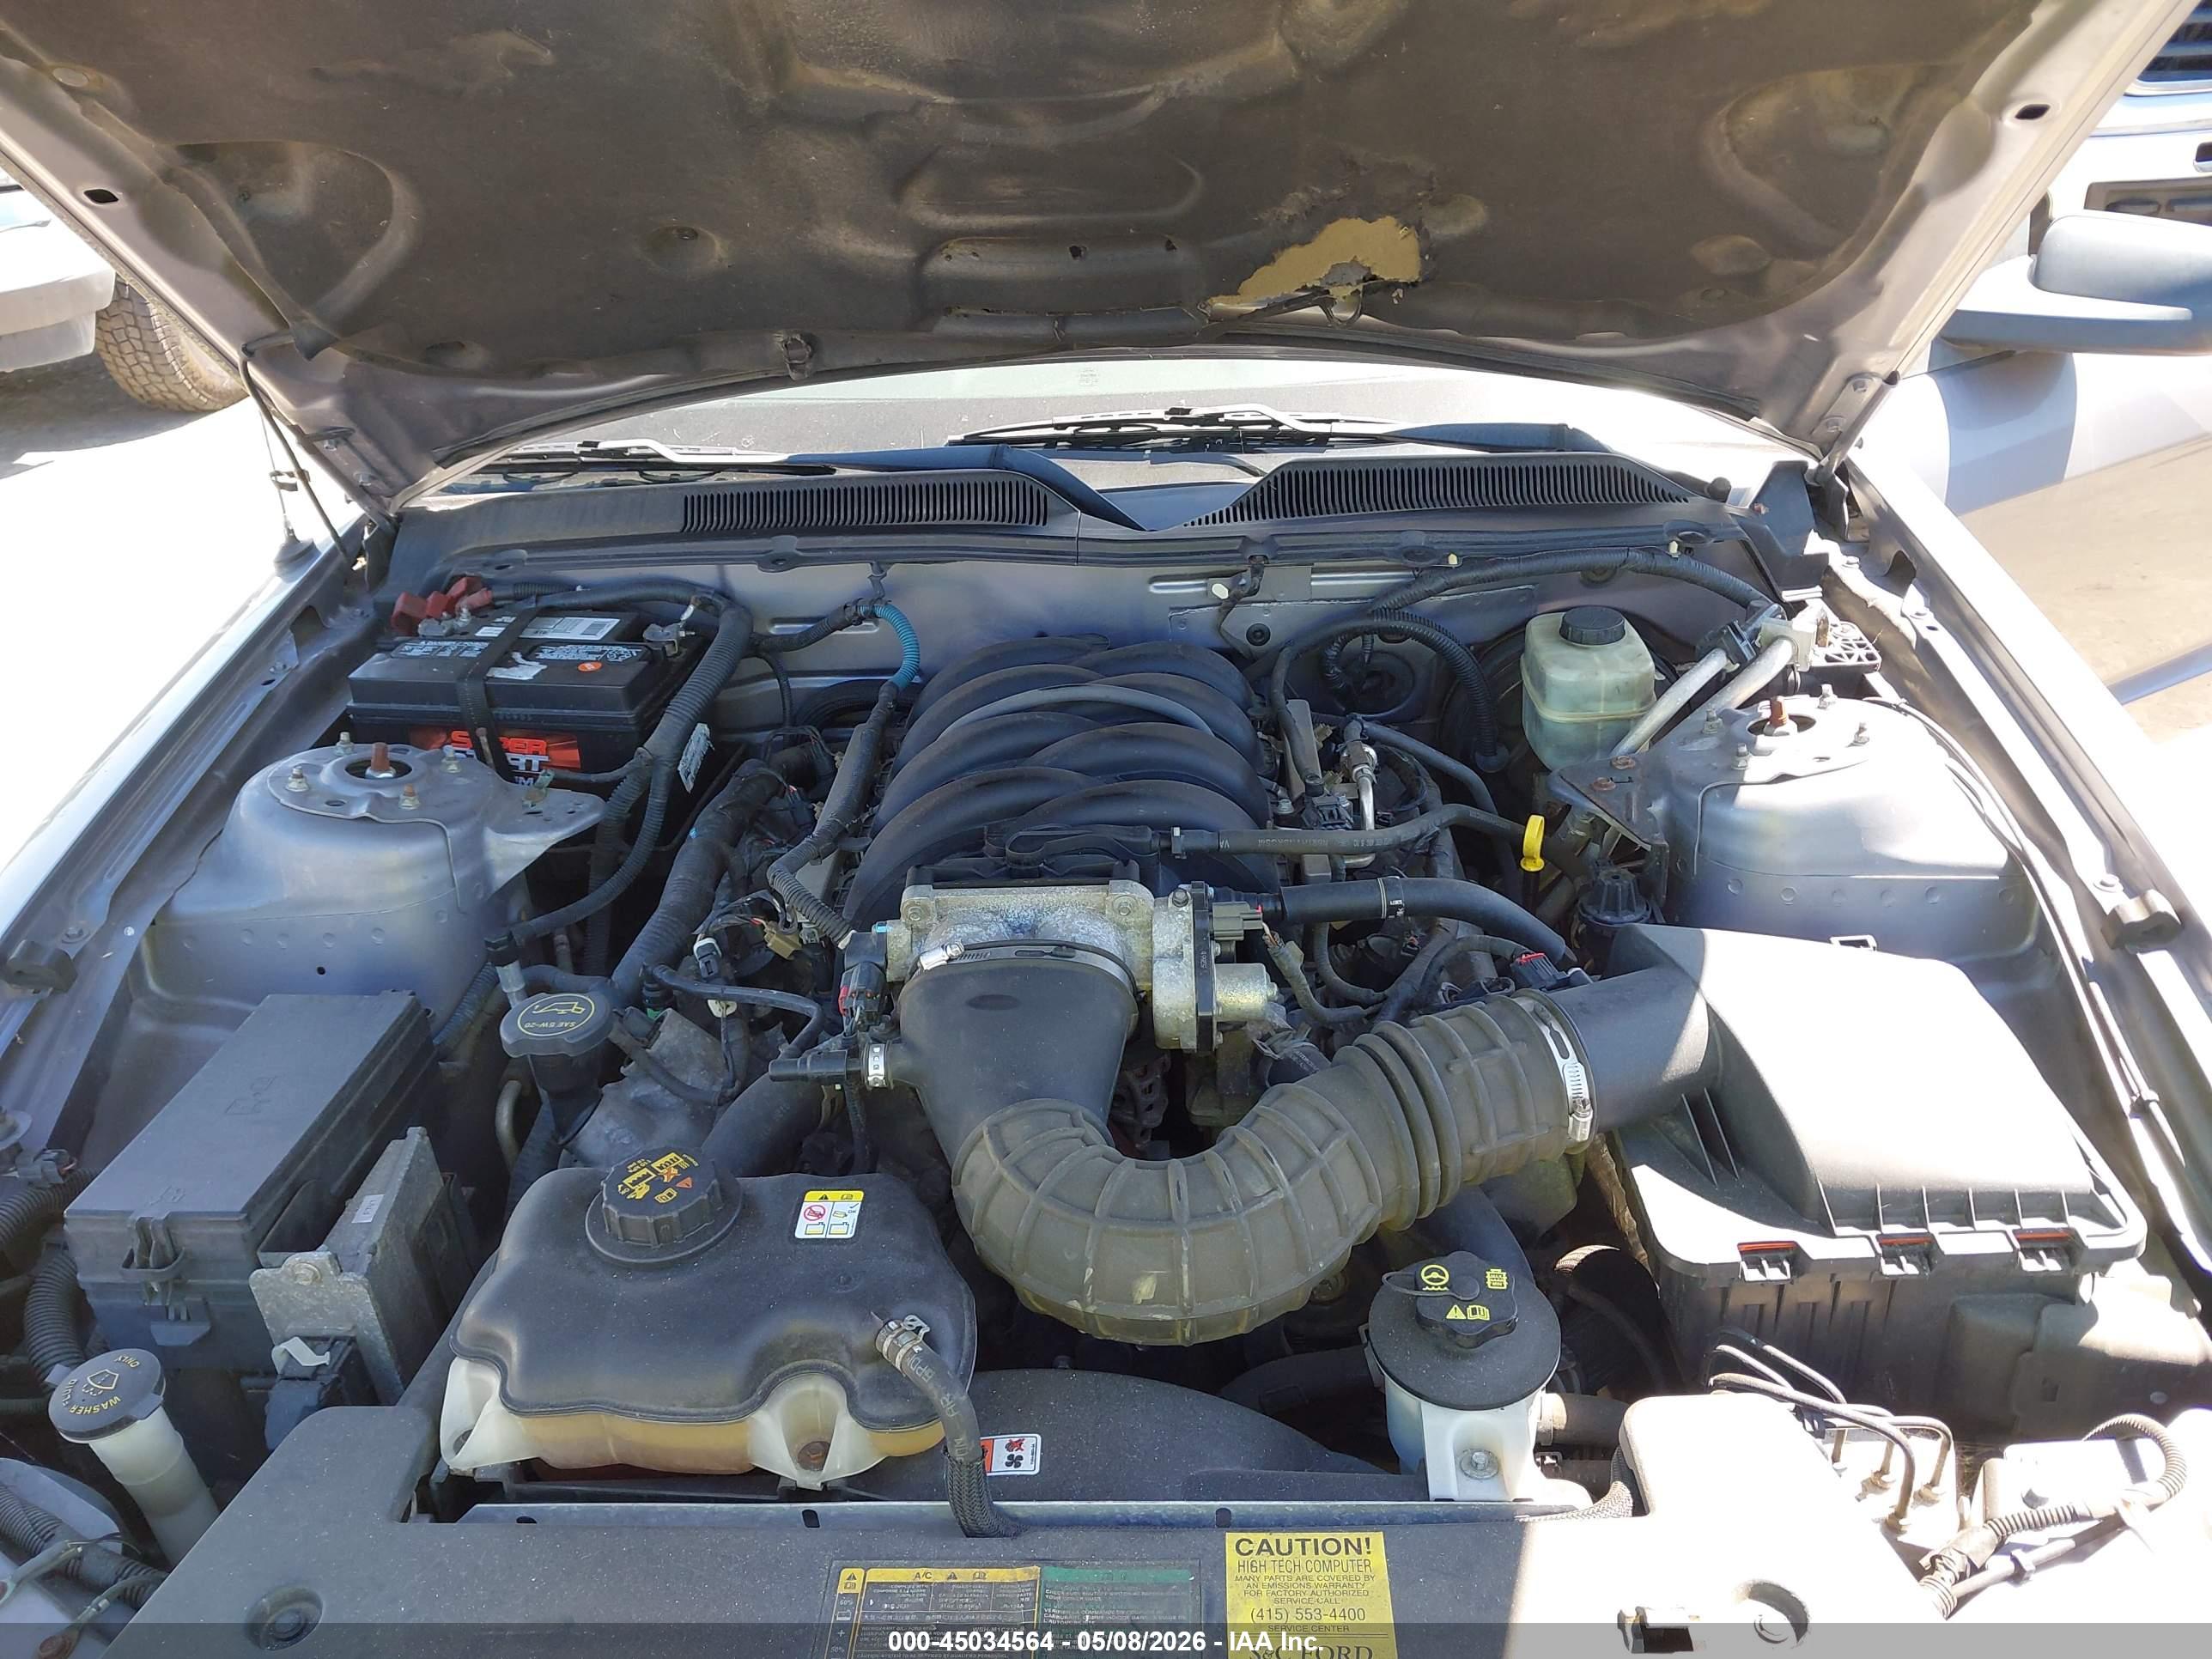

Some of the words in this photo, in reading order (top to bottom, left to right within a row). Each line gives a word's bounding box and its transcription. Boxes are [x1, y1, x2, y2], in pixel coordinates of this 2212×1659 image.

[114, 1354, 141, 1368] ONLY
[62, 1378, 77, 1406] FLUID
[69, 1395, 121, 1414] WASHER
[1235, 1537, 1371, 1557] CAUTION!
[1237, 1559, 1267, 1573] HIGH
[1271, 1559, 1301, 1573] TECH
[1305, 1559, 1372, 1573] COMPUTER
[1250, 1607, 1289, 1624] (415)
[1295, 1607, 1365, 1621] 553-4400
